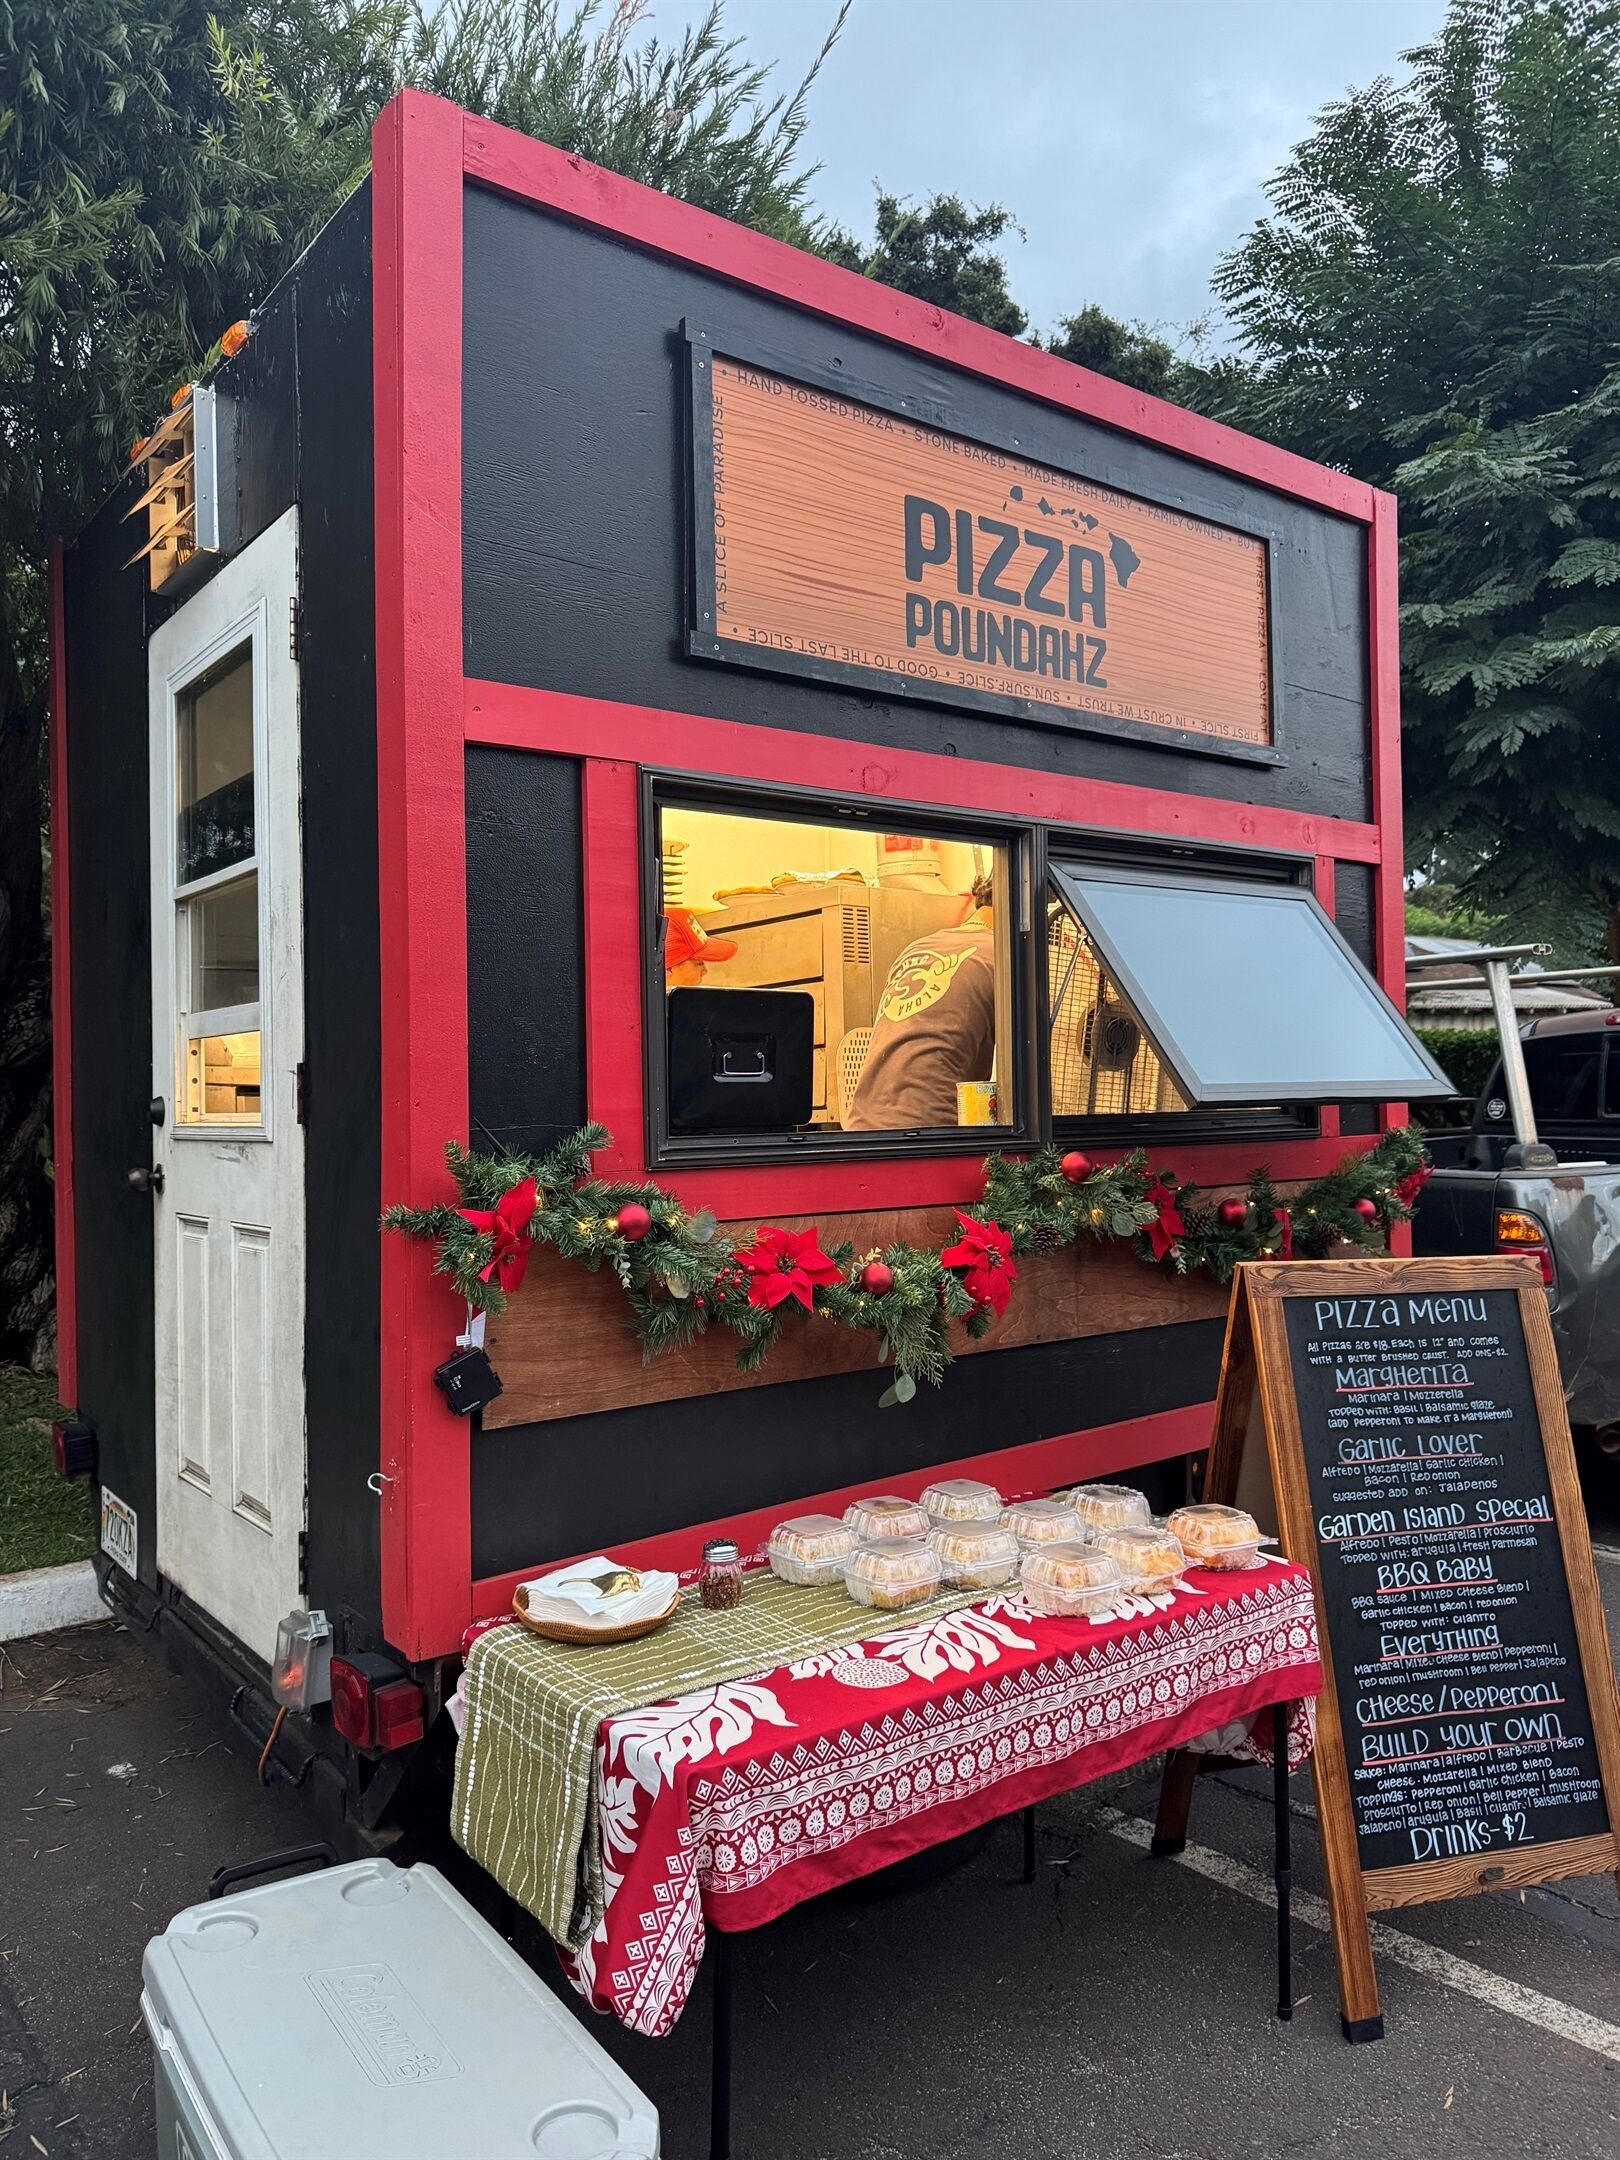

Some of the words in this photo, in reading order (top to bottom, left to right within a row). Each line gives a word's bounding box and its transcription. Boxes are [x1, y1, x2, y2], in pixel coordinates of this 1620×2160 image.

[712, 395, 725, 494] PARADISE
[738, 370, 782, 395] HAND
[787, 385, 848, 416] TOSSED
[852, 408, 893, 433] PIZZA
[914, 430, 960, 454] STONE
[964, 445, 1006, 469] BAKED
[1024, 464, 1057, 487] MADE
[1061, 477, 1098, 499] FRESH
[1101, 491, 1132, 511] DAILY
[1148, 507, 1185, 527] FAMILY
[1187, 519, 1224, 541] OWNED
[1237, 535, 1257, 551] BUT
[715, 502, 726, 528] OF
[715, 535, 727, 594] SLICE
[904, 494, 1107, 628] PIZZA
[716, 600, 727, 614] A
[1257, 606, 1266, 650] PIZZA
[748, 628, 793, 649] SLICE
[799, 639, 836, 658] LAST
[906, 592, 1107, 688] POUNDAHZ
[842, 648, 870, 664] THE
[874, 654, 893, 670] TO
[898, 659, 938, 679] GOOD
[958, 671, 1060, 703] SUN.SURF.SLICE
[1258, 672, 1268, 711] LOVE
[1078, 696, 1114, 715] TRUST
[1117, 703, 1135, 717] WE
[1136, 708, 1172, 725] CRUST
[1176, 715, 1187, 727] IN
[1260, 716, 1268, 735] AT
[1201, 720, 1229, 737] SLICE
[1232, 726, 1259, 742] FIRST
[897, 983, 941, 1016] ALOHA
[1409, 1298, 1487, 1325] Menu
[1308, 1341, 1319, 1352] All
[1355, 1340, 1371, 1350] are
[1337, 1355, 1343, 1363] a
[1417, 1433, 1483, 1456] Lover
[1377, 1561, 1431, 1590] BBQ
[1351, 1595, 1375, 1609] BBQ
[1361, 1729, 1429, 1761] BUILD
[1440, 1721, 1497, 1750] your
